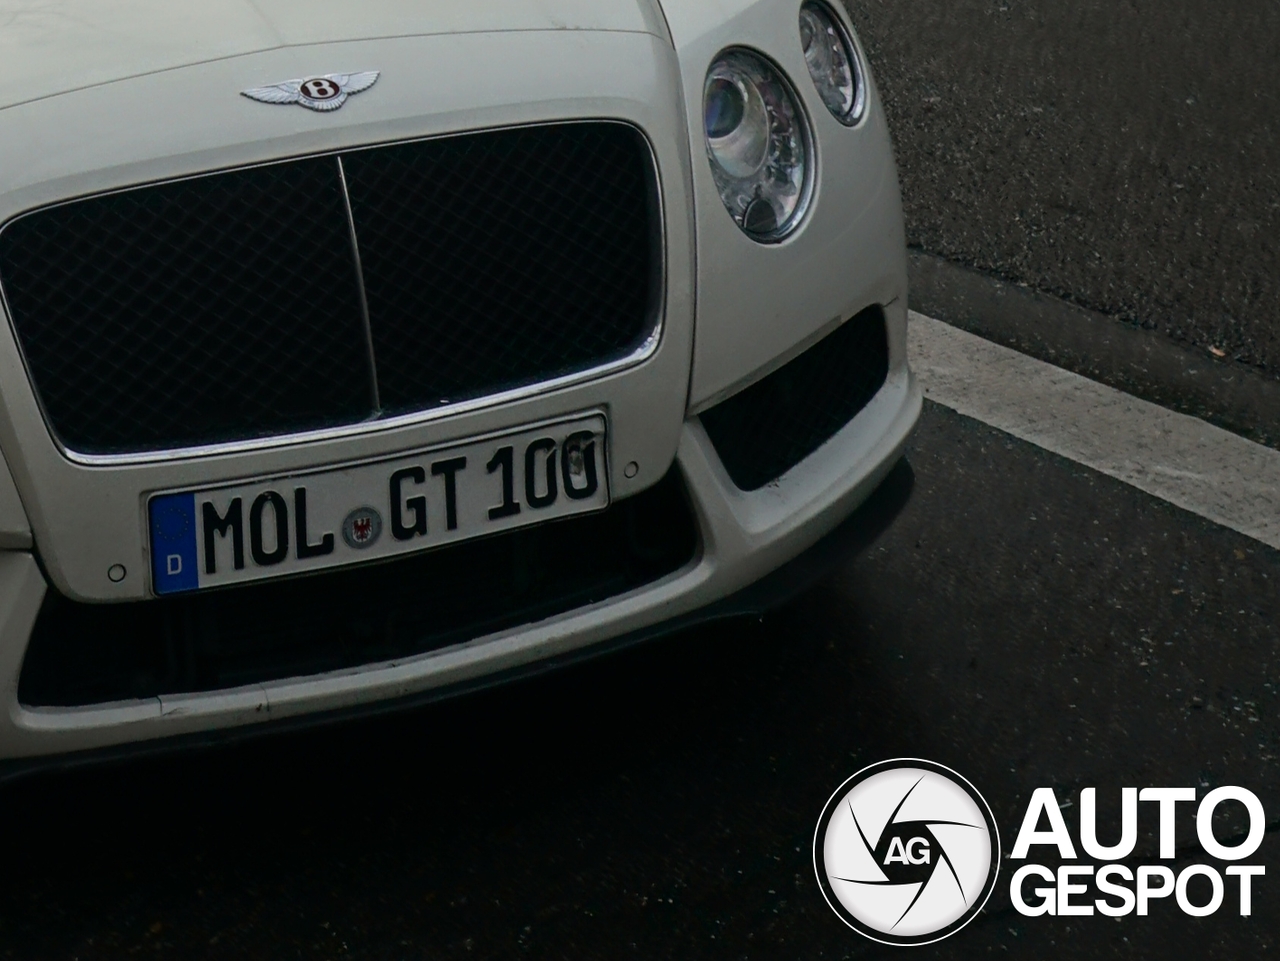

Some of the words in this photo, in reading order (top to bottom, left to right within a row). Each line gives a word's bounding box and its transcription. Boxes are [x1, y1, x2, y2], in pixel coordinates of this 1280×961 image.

[305, 80, 336, 98] B
[202, 487, 335, 575] MOL
[389, 456, 467, 541] GT
[486, 430, 599, 521] 100
[167, 554, 183, 576] D
